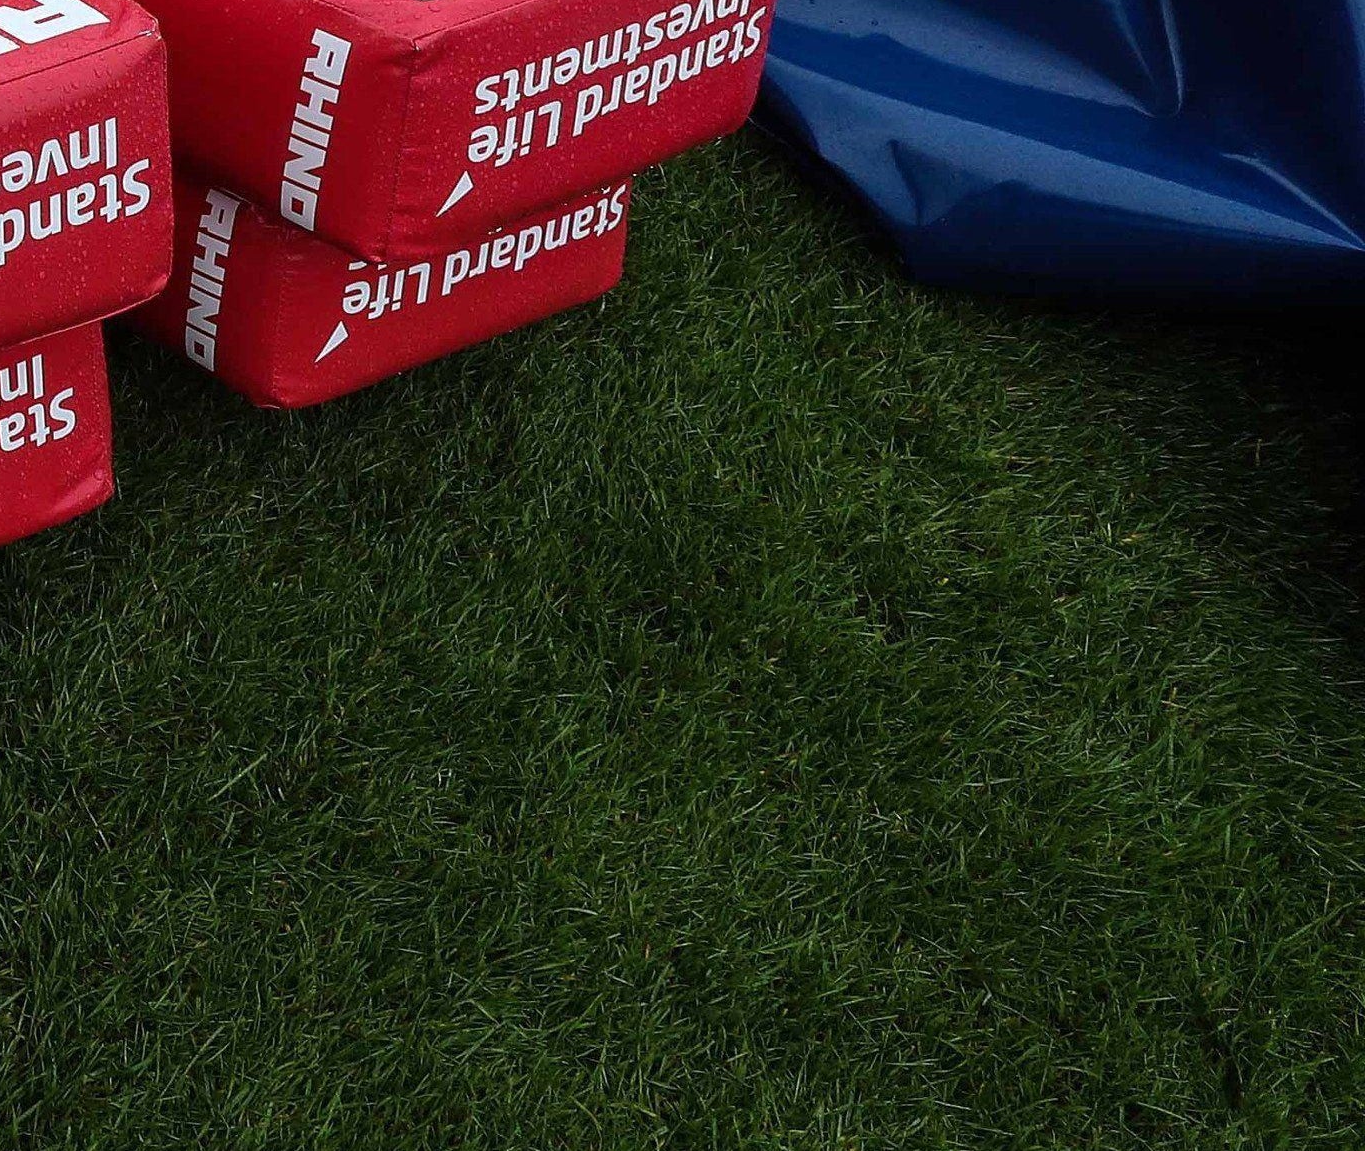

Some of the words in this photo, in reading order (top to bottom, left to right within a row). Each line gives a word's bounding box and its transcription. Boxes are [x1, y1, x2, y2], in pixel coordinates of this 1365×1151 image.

[279, 27, 353, 231] RHINO
[573, 6, 767, 137] Standard
[467, 100, 564, 168] Life
[185, 188, 242, 372] RHINO
[342, 262, 431, 320] Life
[442, 183, 629, 296] Standard
